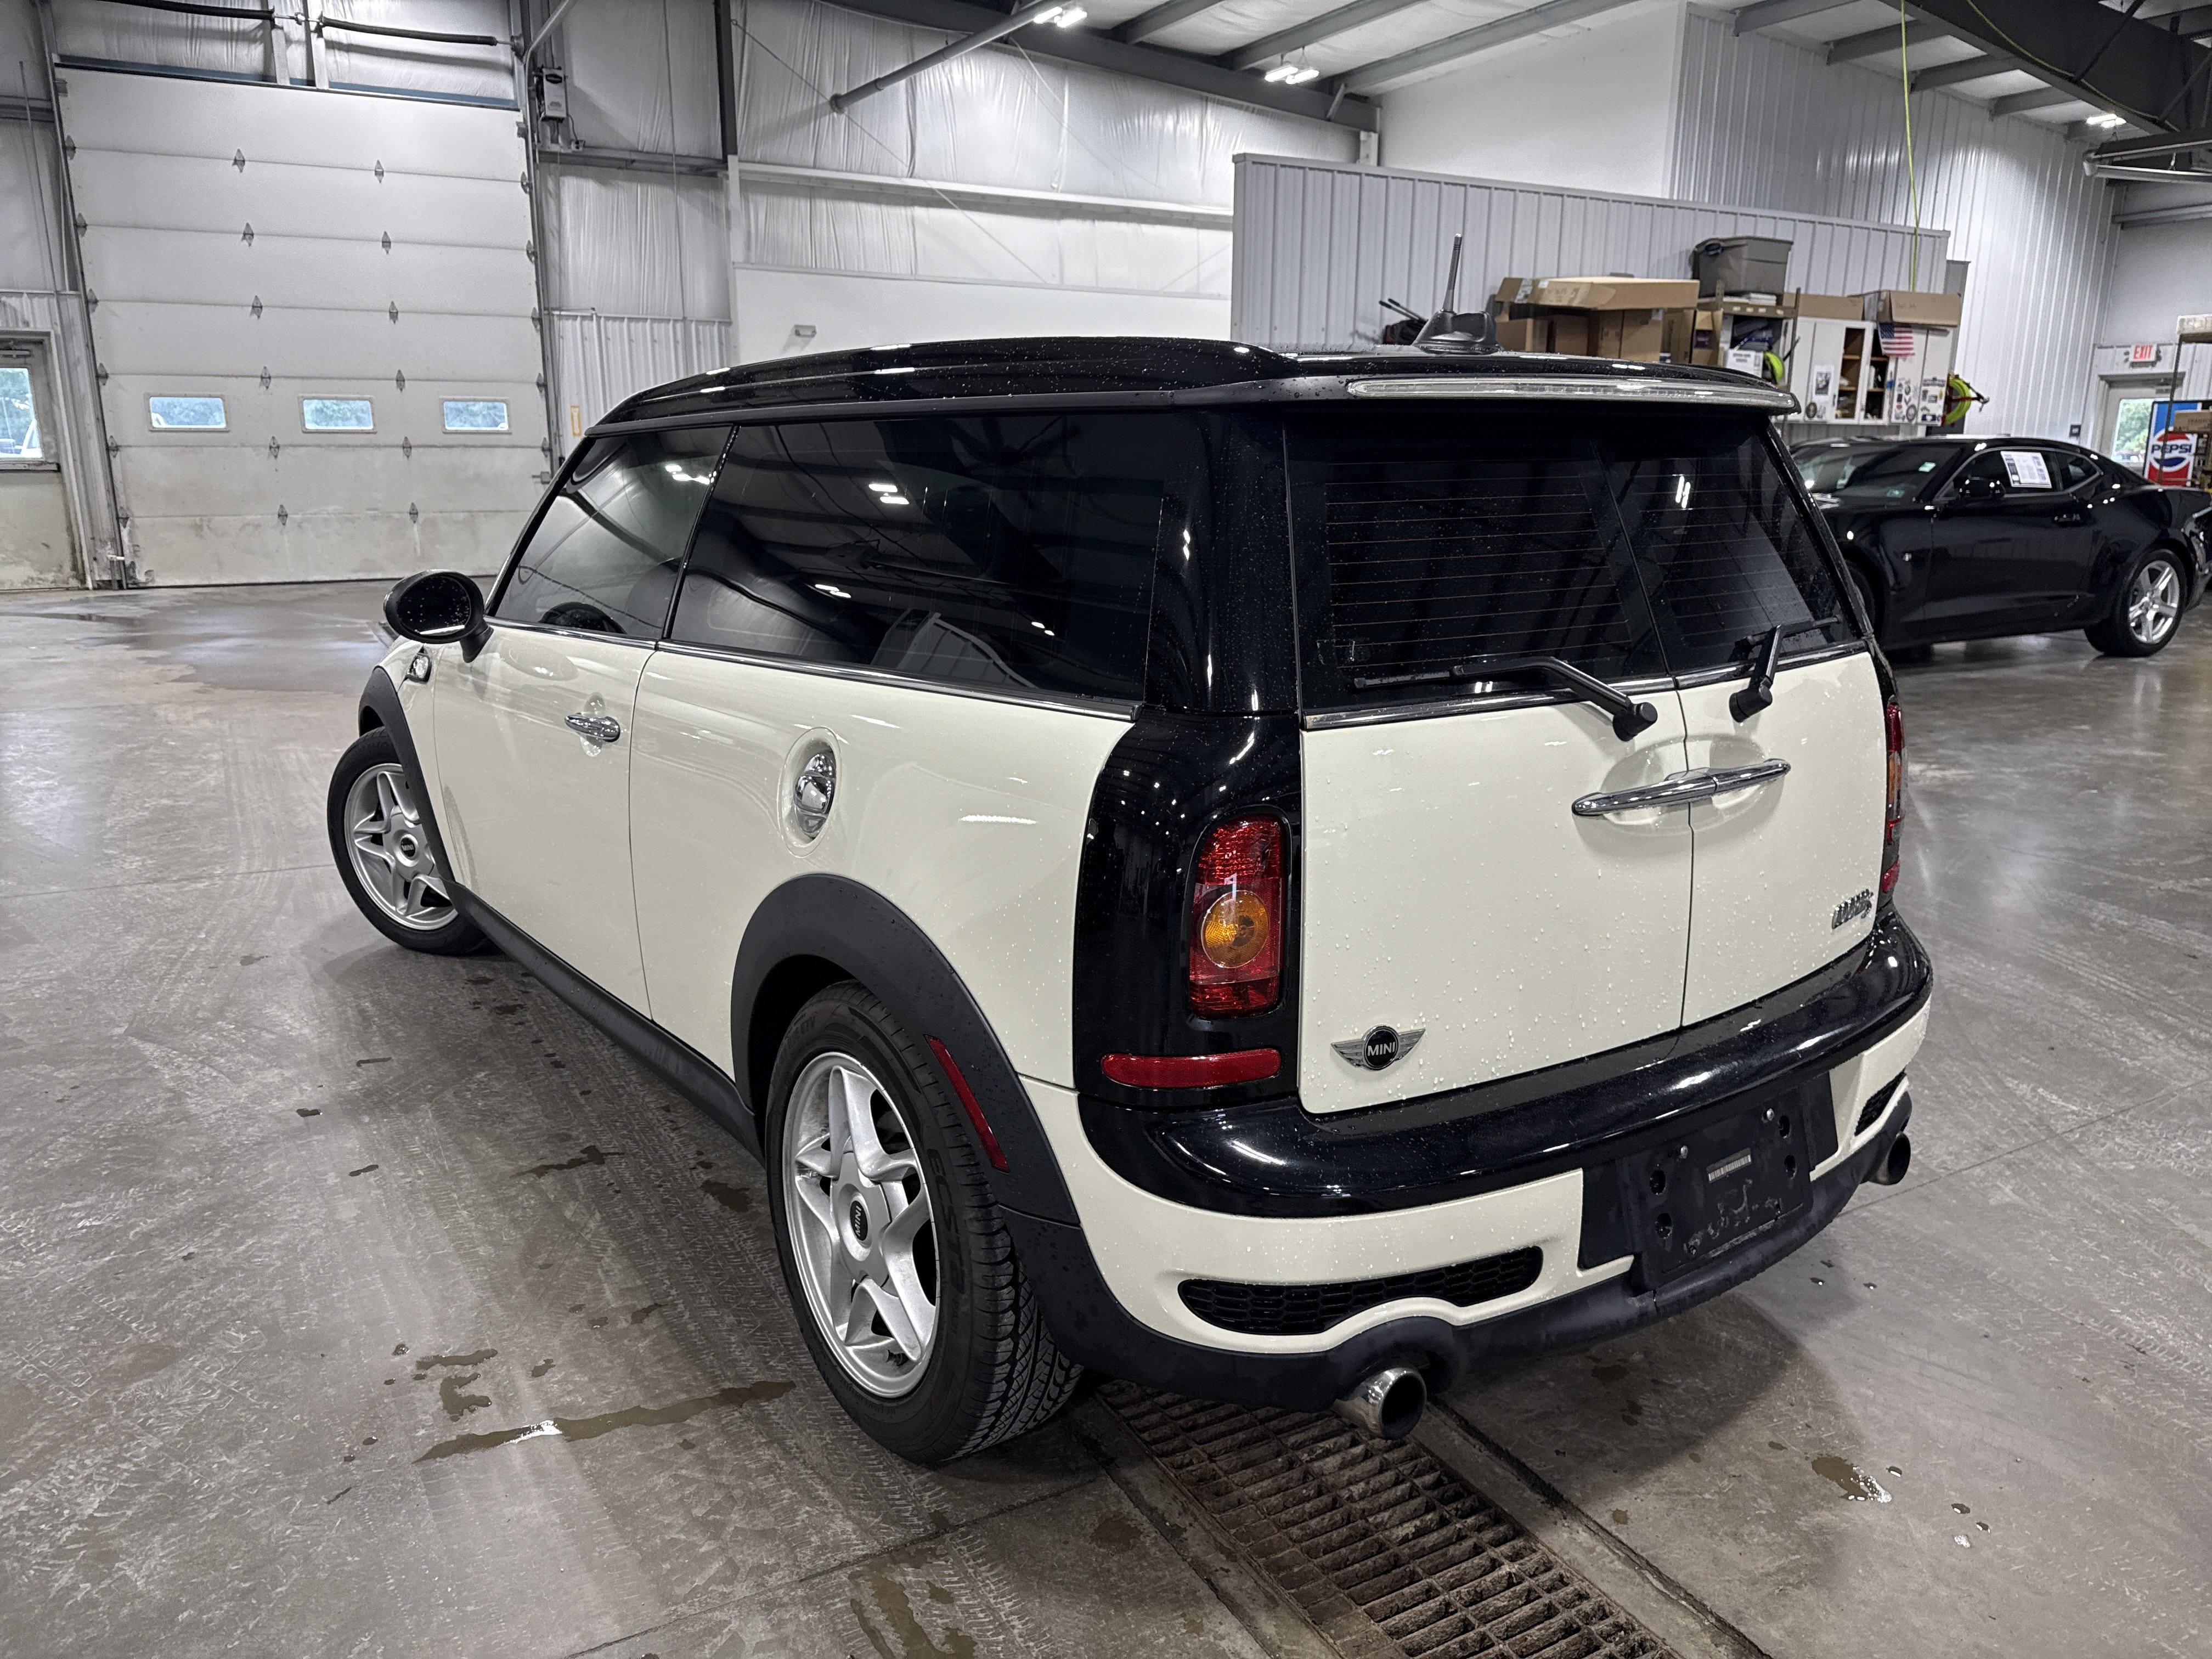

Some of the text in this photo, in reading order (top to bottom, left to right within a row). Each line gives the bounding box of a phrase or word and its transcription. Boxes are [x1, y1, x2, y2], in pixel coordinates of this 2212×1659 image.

[2133, 345, 2153, 360] EXIT
[2151, 444, 2192, 454] PEPSI
[1367, 1041, 1396, 1057] MINI
